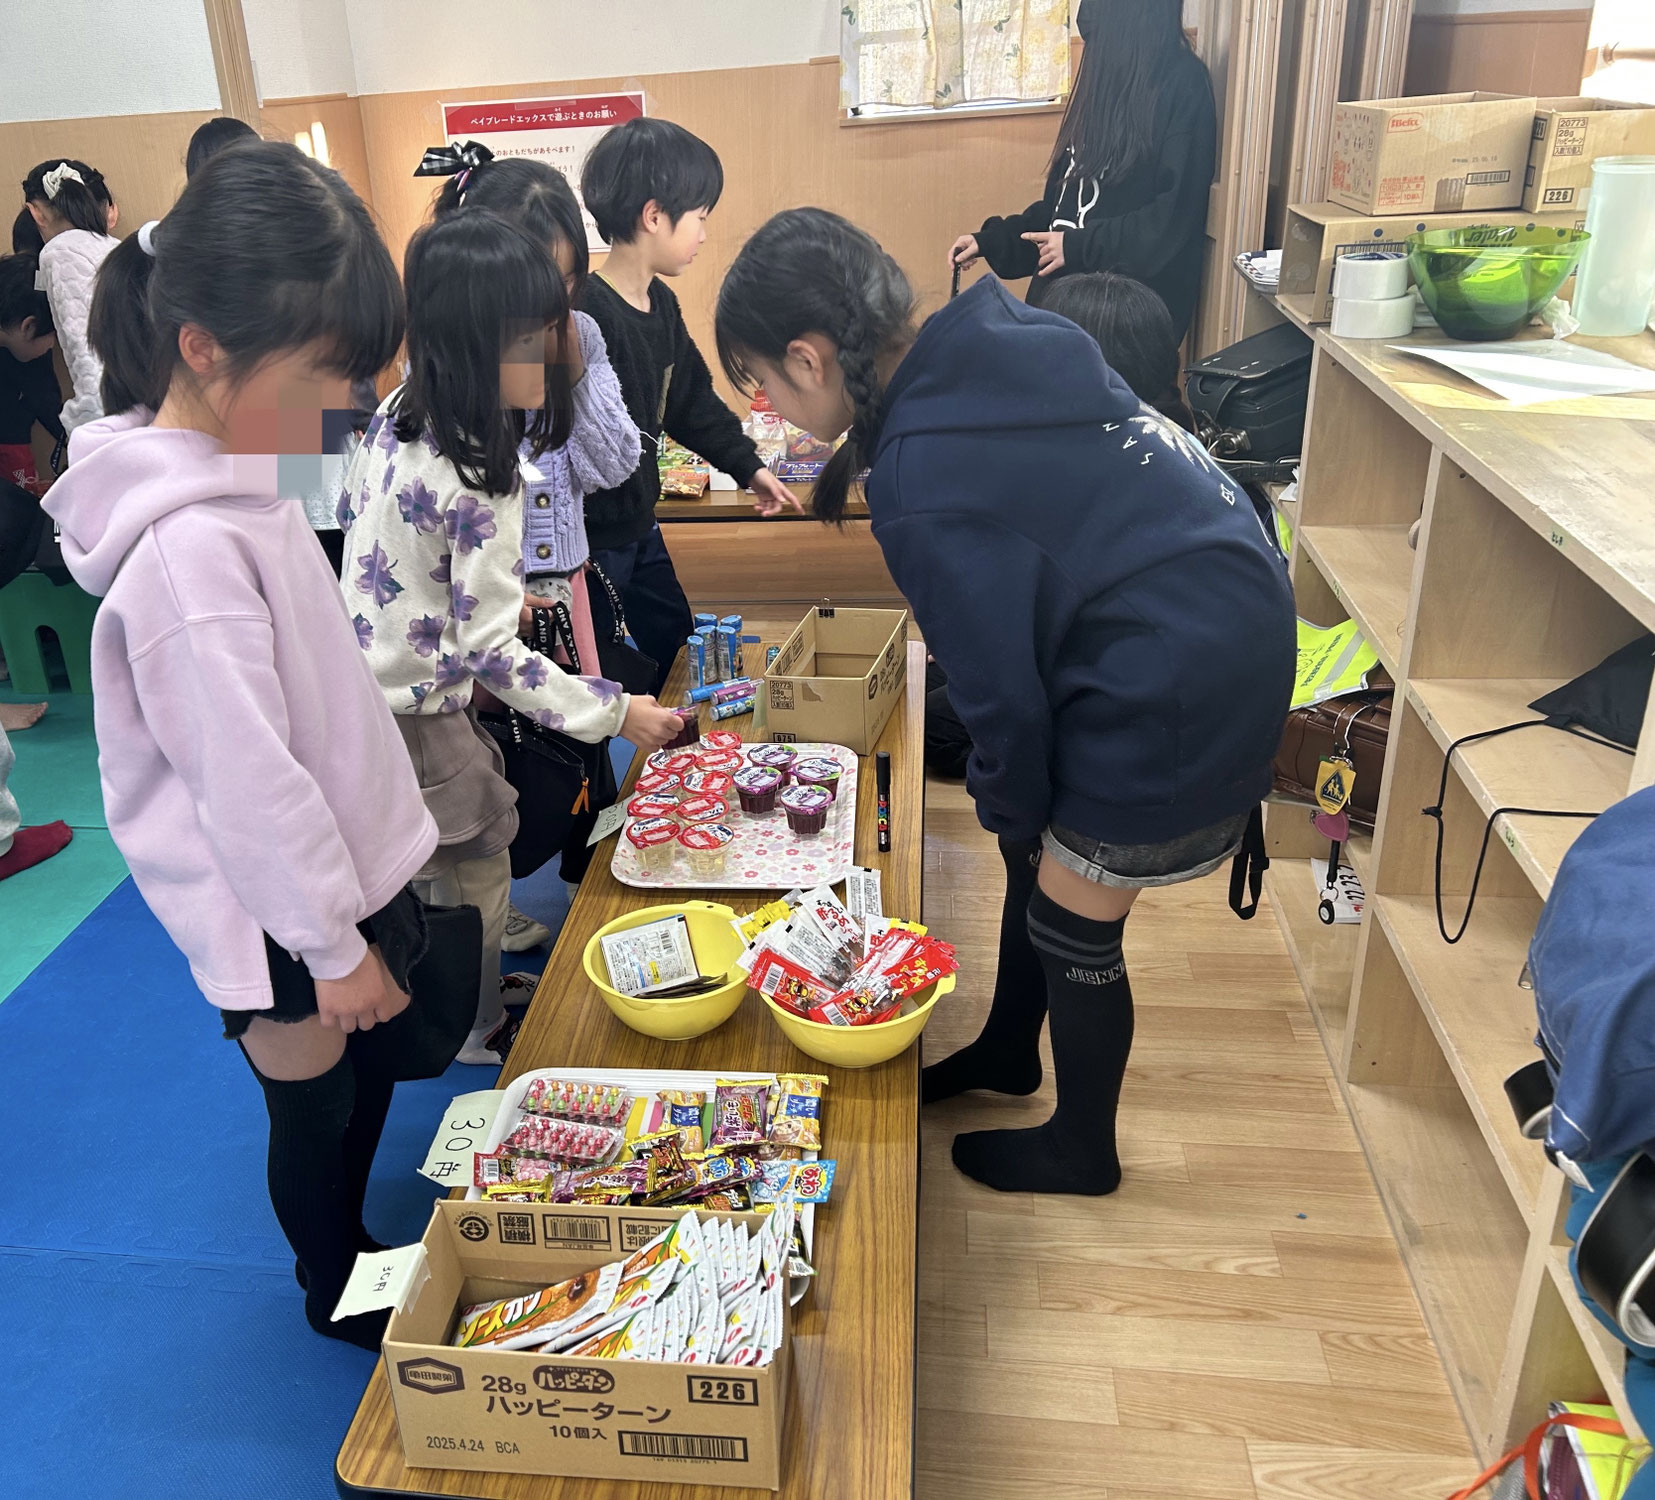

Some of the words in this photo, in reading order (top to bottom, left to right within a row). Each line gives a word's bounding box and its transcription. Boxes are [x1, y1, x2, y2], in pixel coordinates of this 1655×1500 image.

[1558, 129, 1575, 138] 28g
[1560, 119, 1586, 128] 20773
[1548, 191, 1569, 201] 226
[556, 607, 570, 630] AND
[538, 619, 547, 643] AND
[878, 800, 888, 832] POSCA
[481, 1374, 527, 1395] 28g
[700, 1381, 746, 1400] 226
[486, 1395, 672, 1425] ハッピーターン
[549, 1425, 608, 1440] 10個入
[426, 1435, 485, 1452] 2025.4.24
[495, 1440, 521, 1455] BCA
